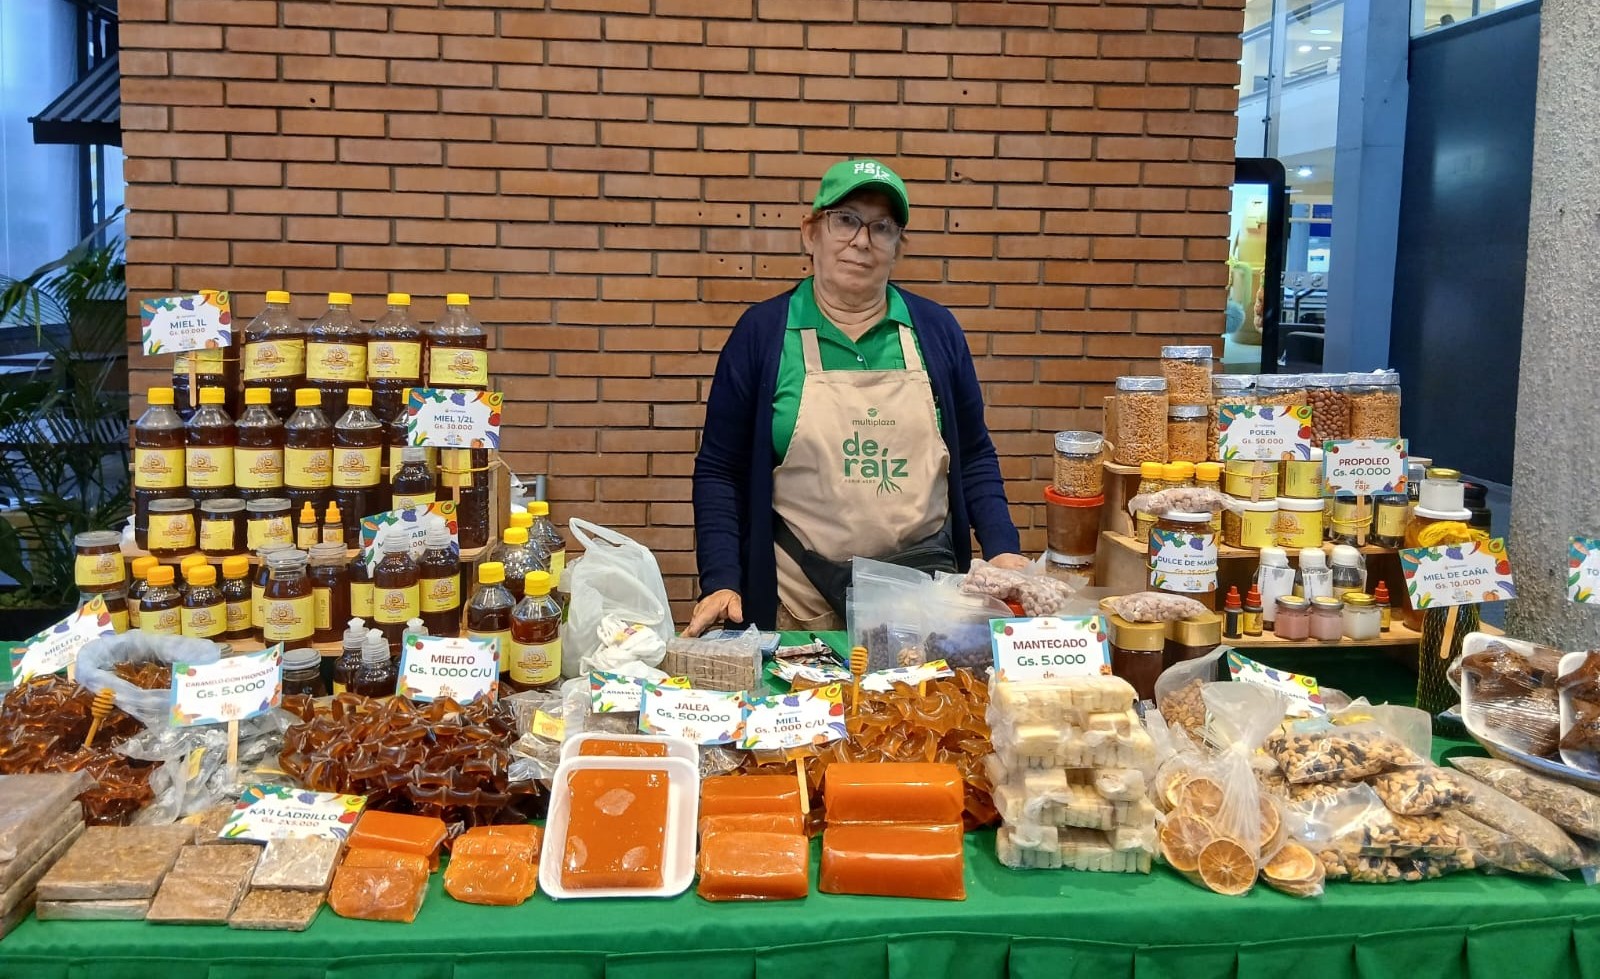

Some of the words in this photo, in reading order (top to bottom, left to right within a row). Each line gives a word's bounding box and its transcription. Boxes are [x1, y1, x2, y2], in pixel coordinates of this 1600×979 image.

[170, 320, 194, 329] MIEL
[197, 318, 207, 327] 1L
[434, 415, 455, 423] MIEL
[457, 415, 474, 423] 1/2L
[852, 419, 896, 427] multiplaza
[842, 431, 879, 457] de
[1333, 469, 1347, 477] Gs.
[1349, 467, 1391, 476] 40.000
[1157, 556, 1183, 566] DULCE
[1423, 573, 1445, 581] MIEL
[1462, 567, 1489, 577] CAÑA
[1450, 579, 1481, 588] 10.000
[45, 634, 81, 657] MIELITO
[1013, 638, 1088, 650] MANTECADO
[431, 654, 475, 665] MIELITO
[1017, 656, 1039, 666] Gs.
[1041, 654, 1086, 666] 5.000
[409, 664, 427, 675] Gs.
[431, 667, 468, 677] 1.000
[470, 668, 492, 677] C/U
[186, 677, 224, 687] CARAMELO
[196, 690, 218, 699] Gs.
[222, 679, 266, 696] 5.000
[674, 702, 710, 712] JALEA
[656, 708, 675, 720] Gs.
[678, 713, 731, 723] 50.000
[776, 716, 801, 726] MIEL
[774, 723, 801, 733] 1.000
[805, 719, 825, 728] C/U
[276, 810, 339, 821] LADRILLO
